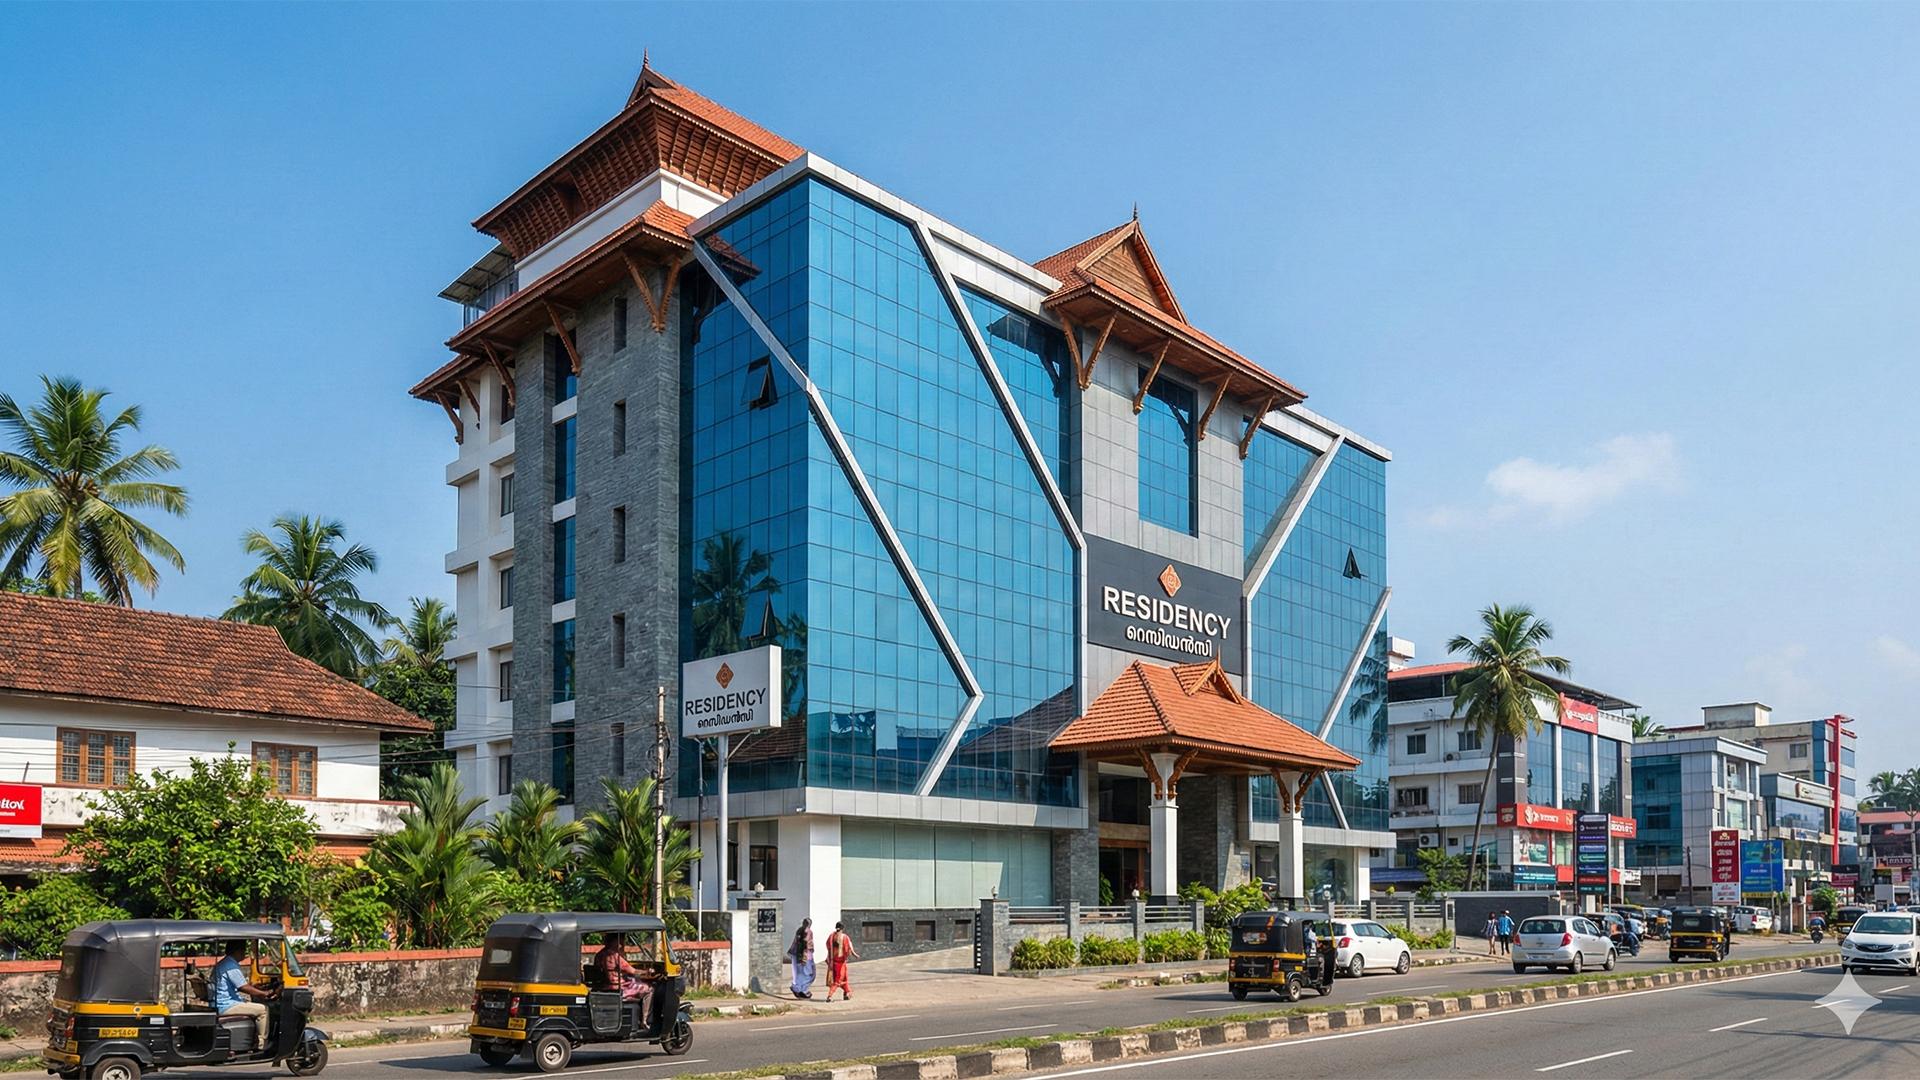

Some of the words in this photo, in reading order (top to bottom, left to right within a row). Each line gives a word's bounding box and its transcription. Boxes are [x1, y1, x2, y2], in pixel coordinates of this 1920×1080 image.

[1104, 586, 1231, 639] RESIDENCY
[1127, 626, 1212, 657] റെസിഡൻസി
[685, 688, 766, 716] RESIDENCY
[698, 709, 753, 728] റെസിഡൻസി
